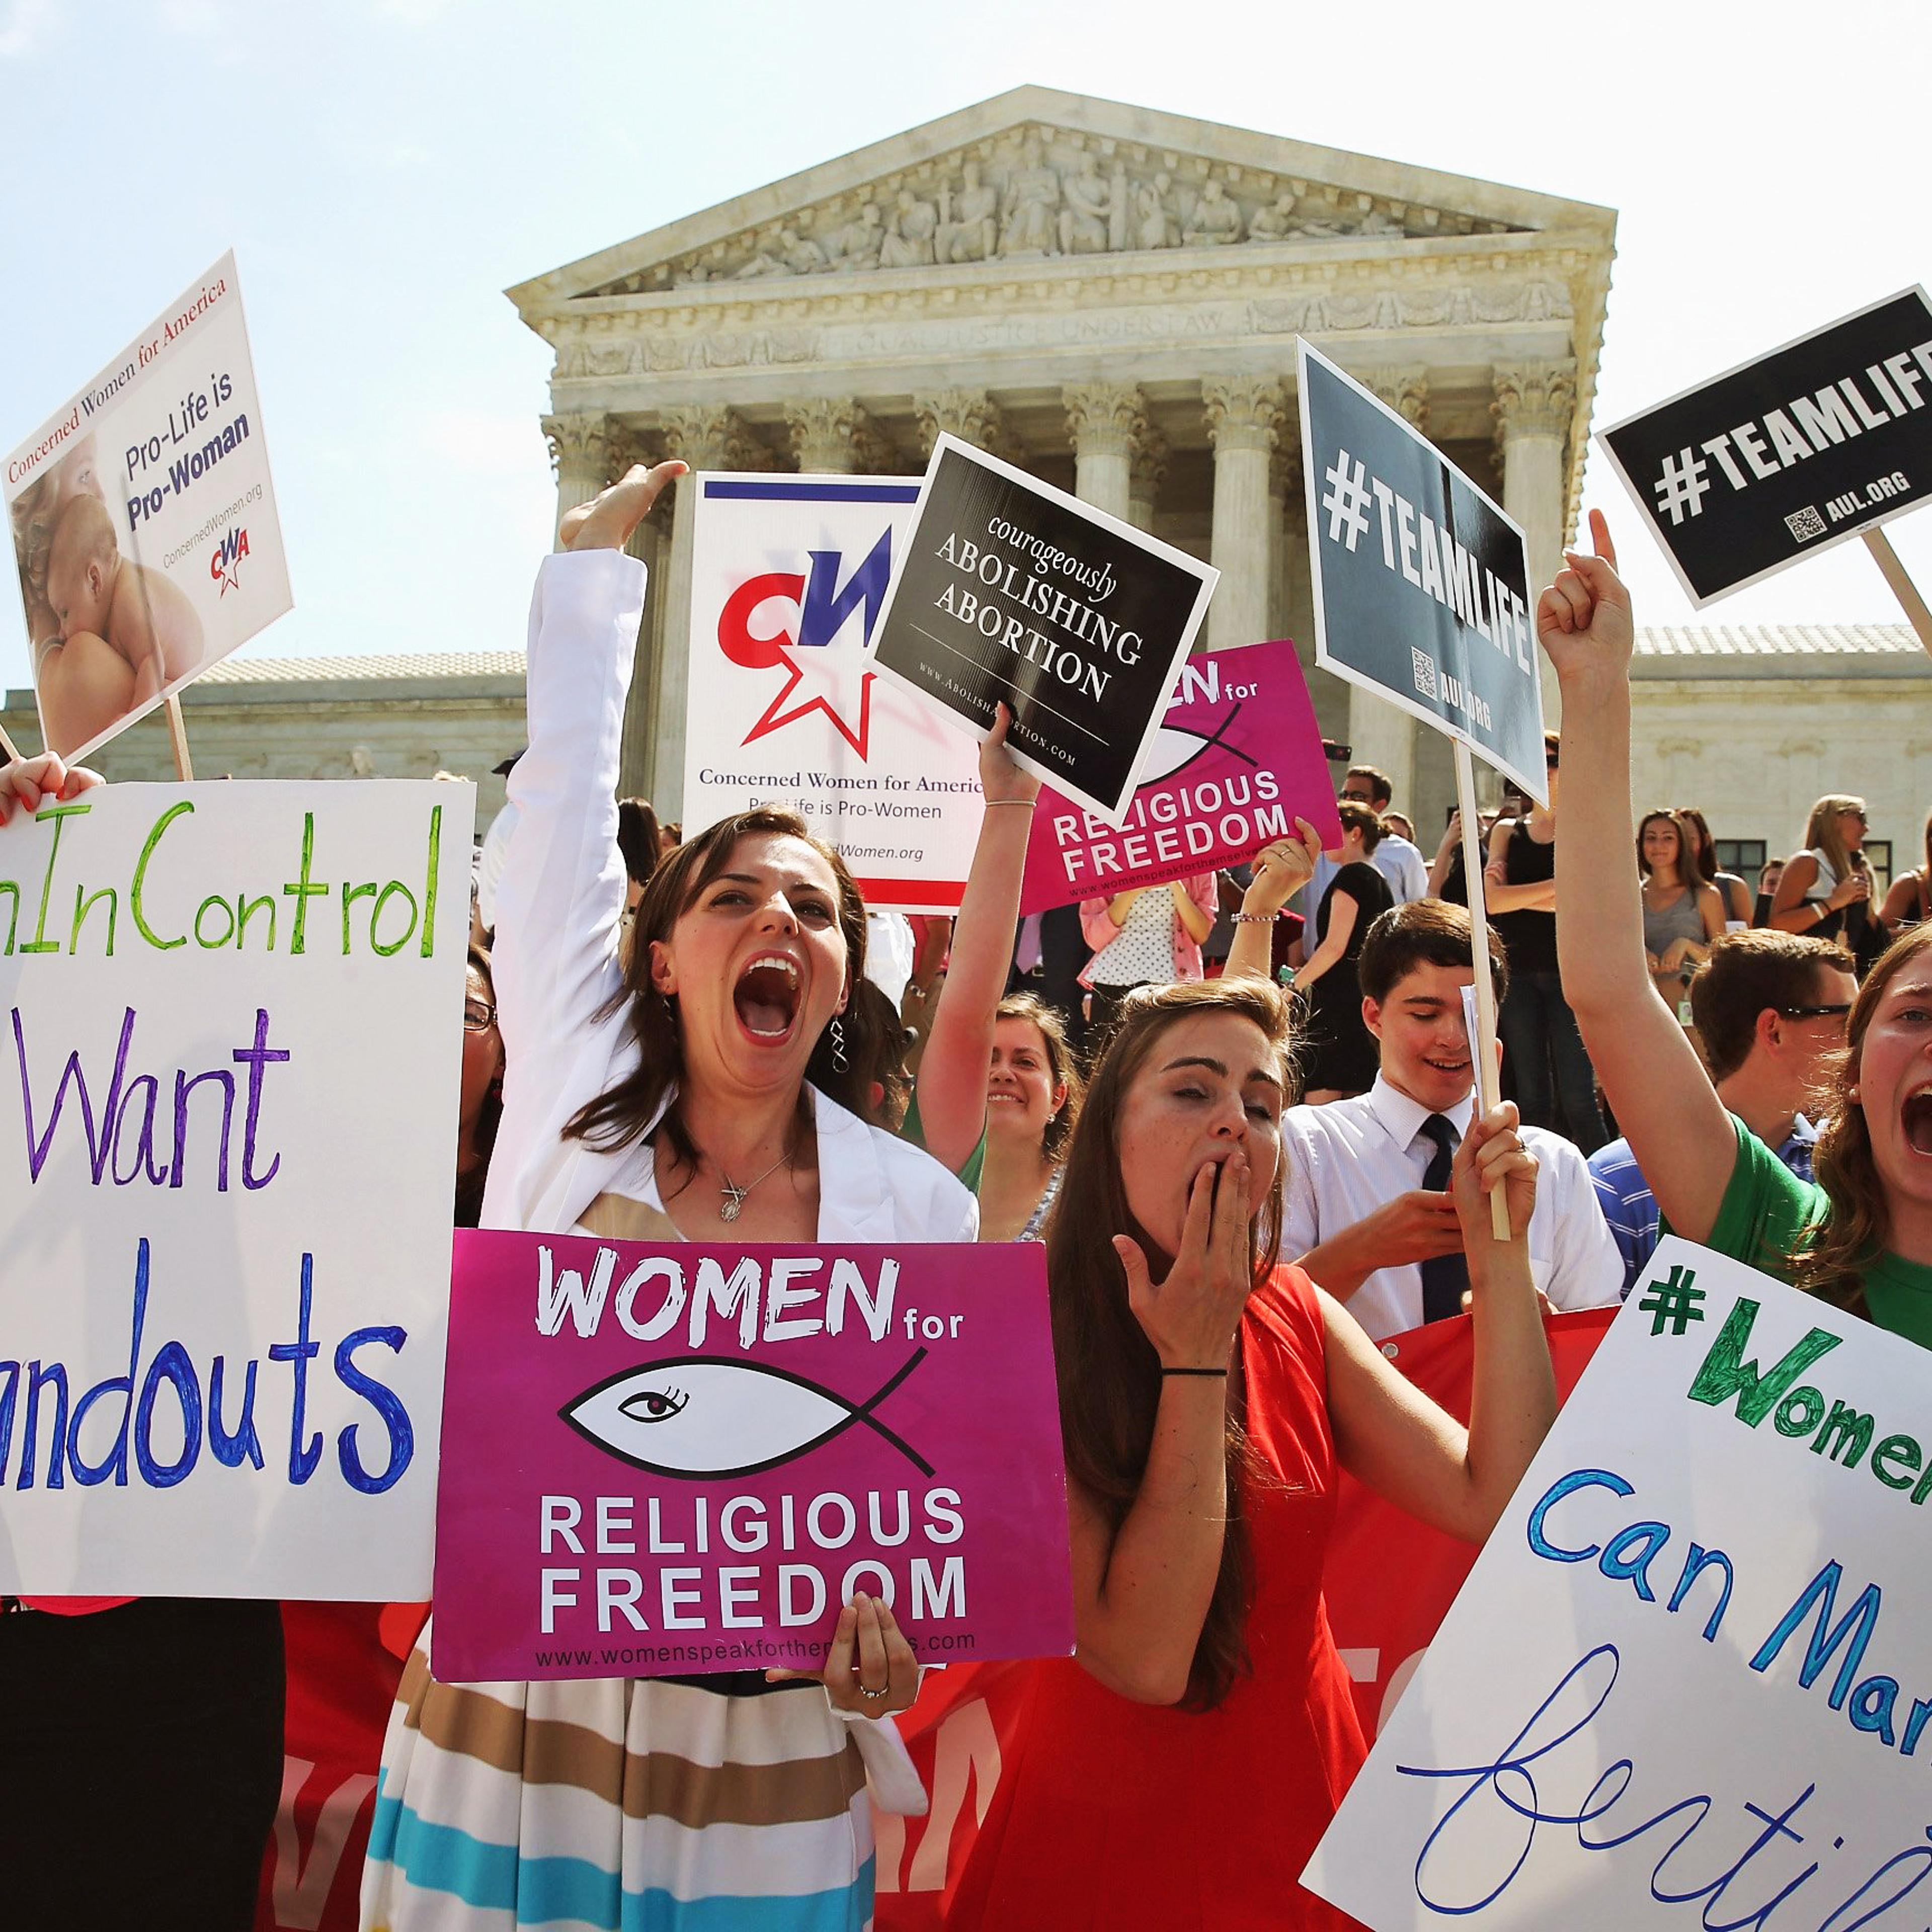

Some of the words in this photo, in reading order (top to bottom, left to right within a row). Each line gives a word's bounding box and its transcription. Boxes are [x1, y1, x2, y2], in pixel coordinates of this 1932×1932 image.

[1063, 314, 1156, 340] UNDER
[8, 408, 80, 484] Concerned
[82, 362, 136, 418] Women
[137, 341, 159, 370] for
[163, 278, 226, 348] America
[125, 392, 208, 481] Pro-Life
[211, 373, 232, 408] is
[127, 413, 249, 531] Pro-Woman
[1825, 470, 1911, 522] AUL.ORG
[164, 483, 263, 569] ConcernedWomen.org
[211, 526, 250, 580] CWA
[988, 516, 1116, 603] courageously
[1322, 448, 1531, 676] #TEAMLIFE
[717, 525, 891, 669] CW
[935, 532, 1143, 666] ABOLISHING
[934, 583, 1112, 703] ABORTION
[1225, 682, 1258, 701] for
[1440, 671, 1491, 732] AUL.ORG
[699, 769, 800, 788] Concerned
[808, 773, 878, 790] Women
[884, 775, 910, 792] for
[916, 777, 984, 794] Americ
[820, 799, 833, 815] is
[840, 801, 942, 819] Pro-Women
[1062, 804, 1289, 882] FREEDOM
[11, 1007, 290, 1192] Want
[535, 1246, 901, 1349] WOMEN
[903, 1308, 965, 1340] for
[540, 1488, 966, 1555] RELIGIOUS
[1526, 1468, 1734, 1643] Can
[540, 1556, 968, 1634] FREEDOM
[536, 1632, 975, 1667] www.womenspeakforthes.com
